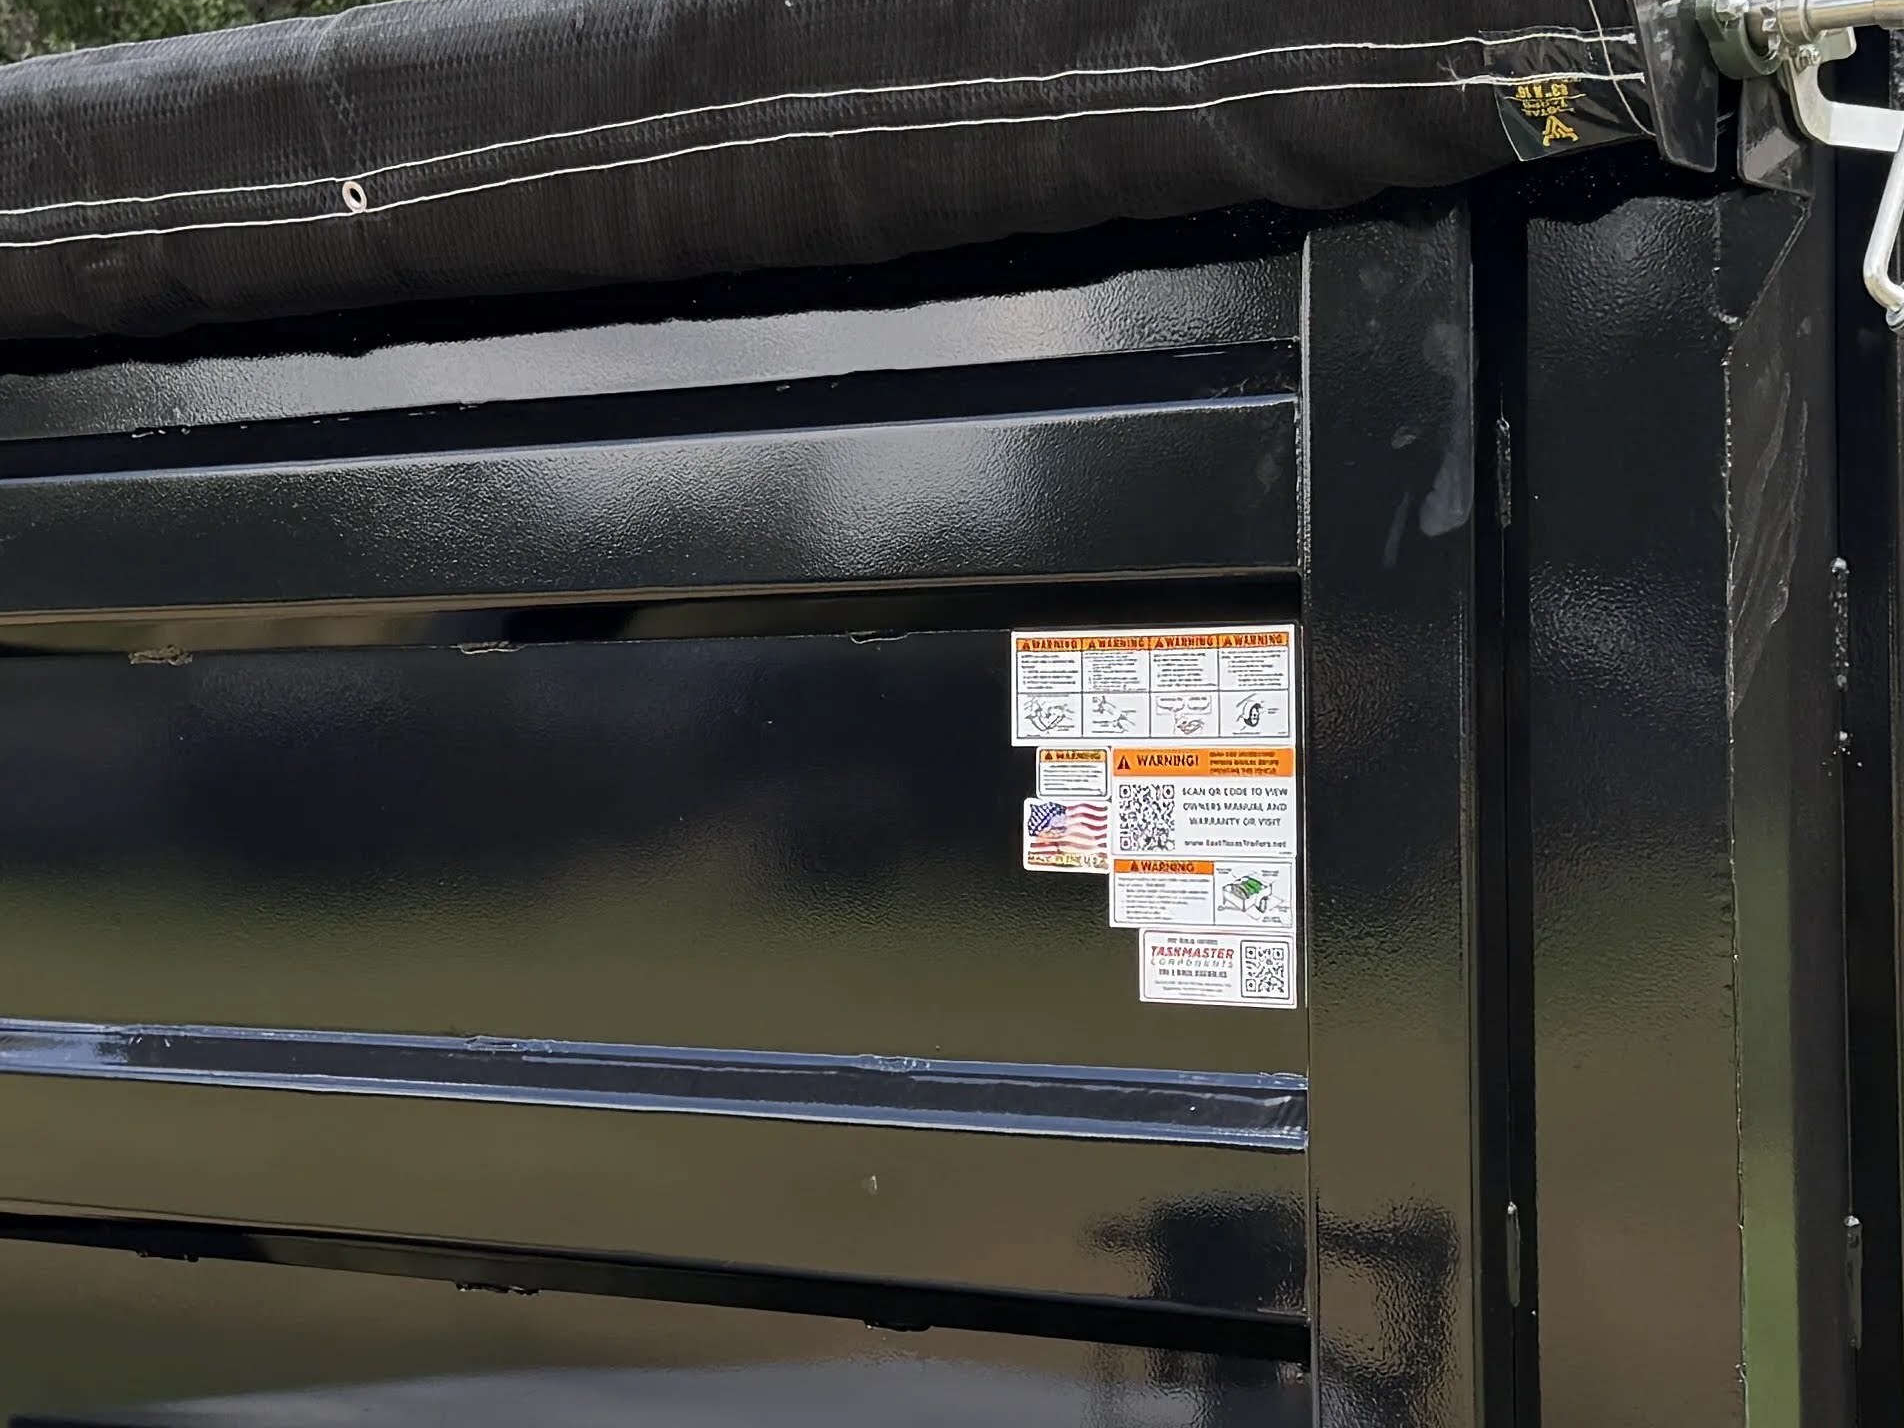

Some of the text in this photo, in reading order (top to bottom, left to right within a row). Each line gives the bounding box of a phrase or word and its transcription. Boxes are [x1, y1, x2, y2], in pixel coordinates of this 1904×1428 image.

[1166, 636, 1214, 649] WARNING
[1233, 634, 1284, 647] WARNING
[1137, 755, 1199, 767] WARNING!
[1182, 787, 1288, 796] SCAN QR CODE TO VIEW
[1267, 802, 1288, 811] AND
[1189, 817, 1281, 826] WARRANTY OR VISIT
[1142, 861, 1194, 872] WARNING
[1151, 946, 1234, 959] TASKMASTER
